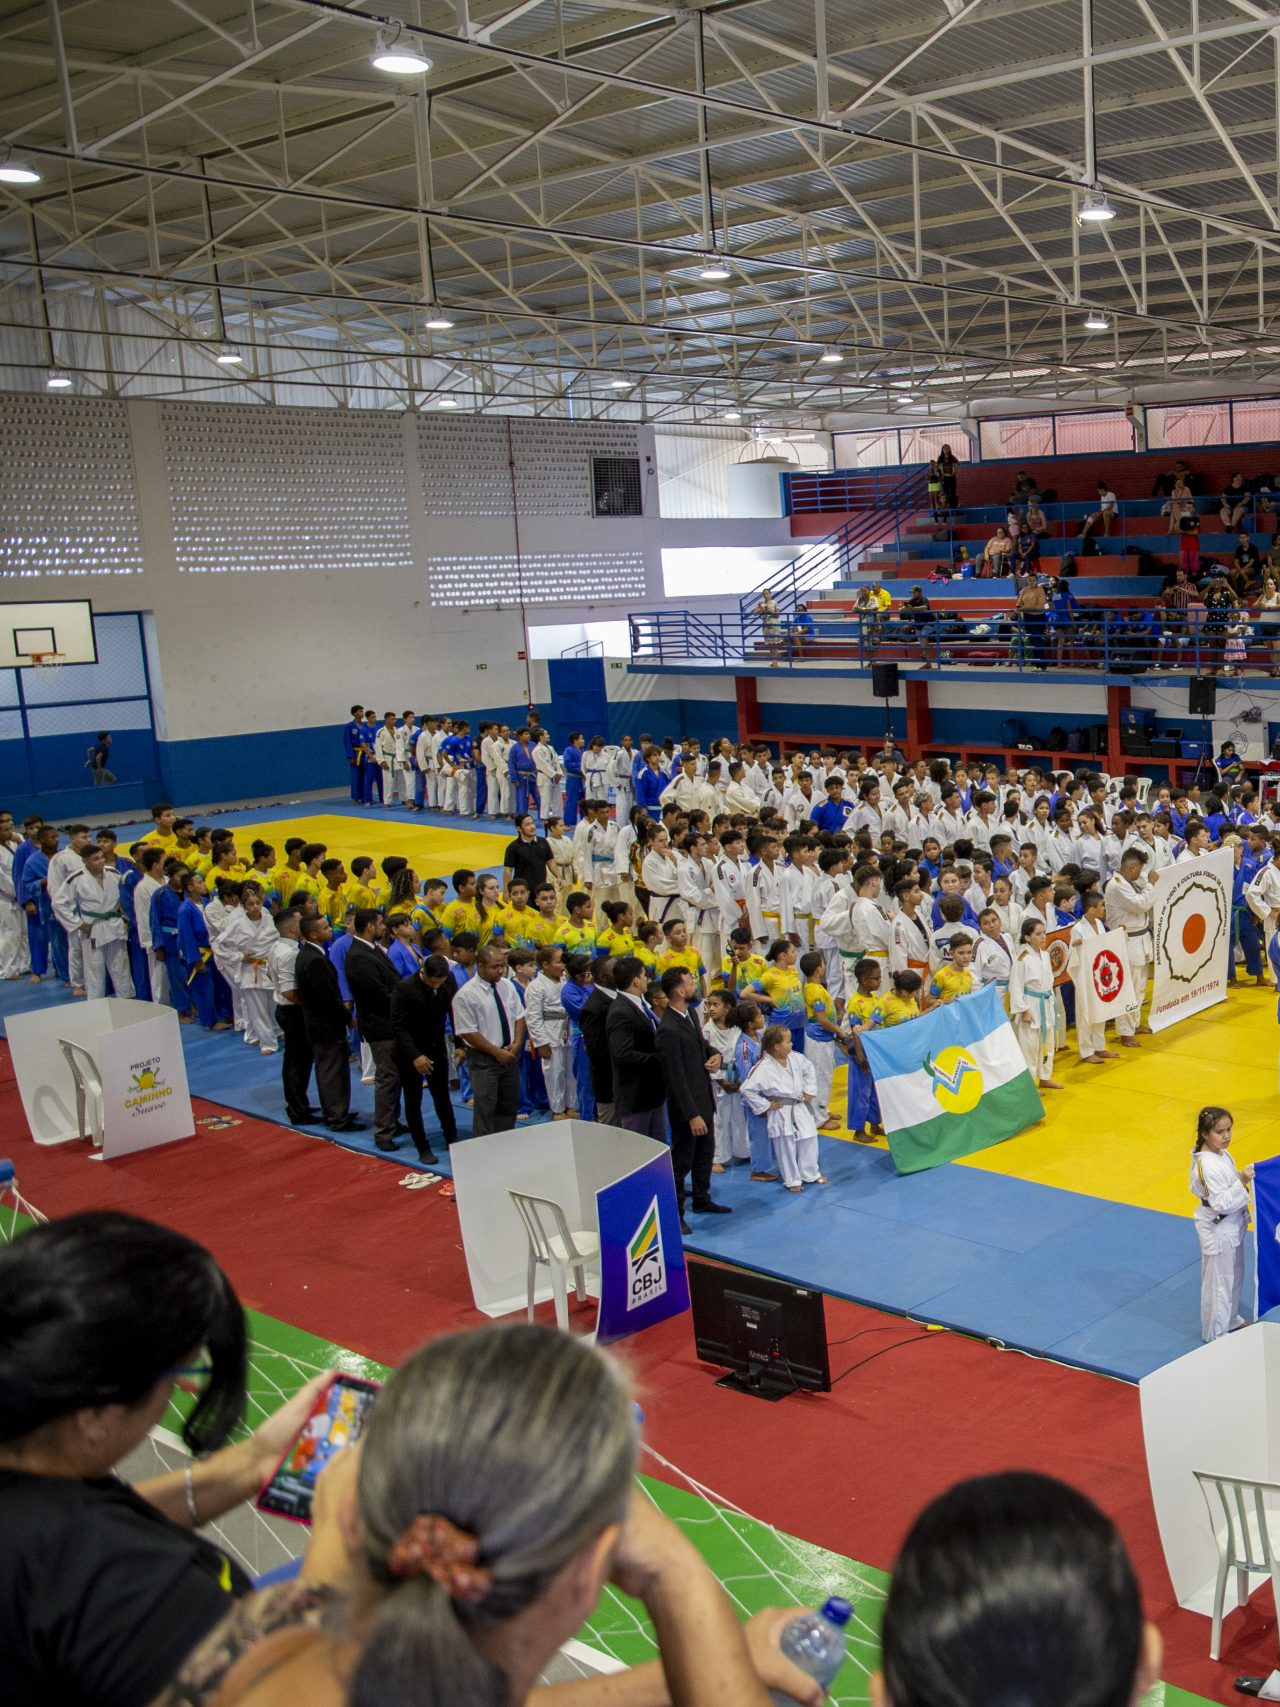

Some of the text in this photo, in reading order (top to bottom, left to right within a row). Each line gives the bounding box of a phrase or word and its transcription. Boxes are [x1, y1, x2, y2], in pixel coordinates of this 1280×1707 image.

[1181, 870, 1203, 885] CULTURA
[1156, 998, 1180, 1014] Fundada
[1180, 994, 1190, 1004] em
[130, 1056, 161, 1071] PROJETO
[124, 1087, 173, 1109] CAMINHO
[632, 1266, 662, 1296] CBJ
[631, 1284, 663, 1304] BRASIL
